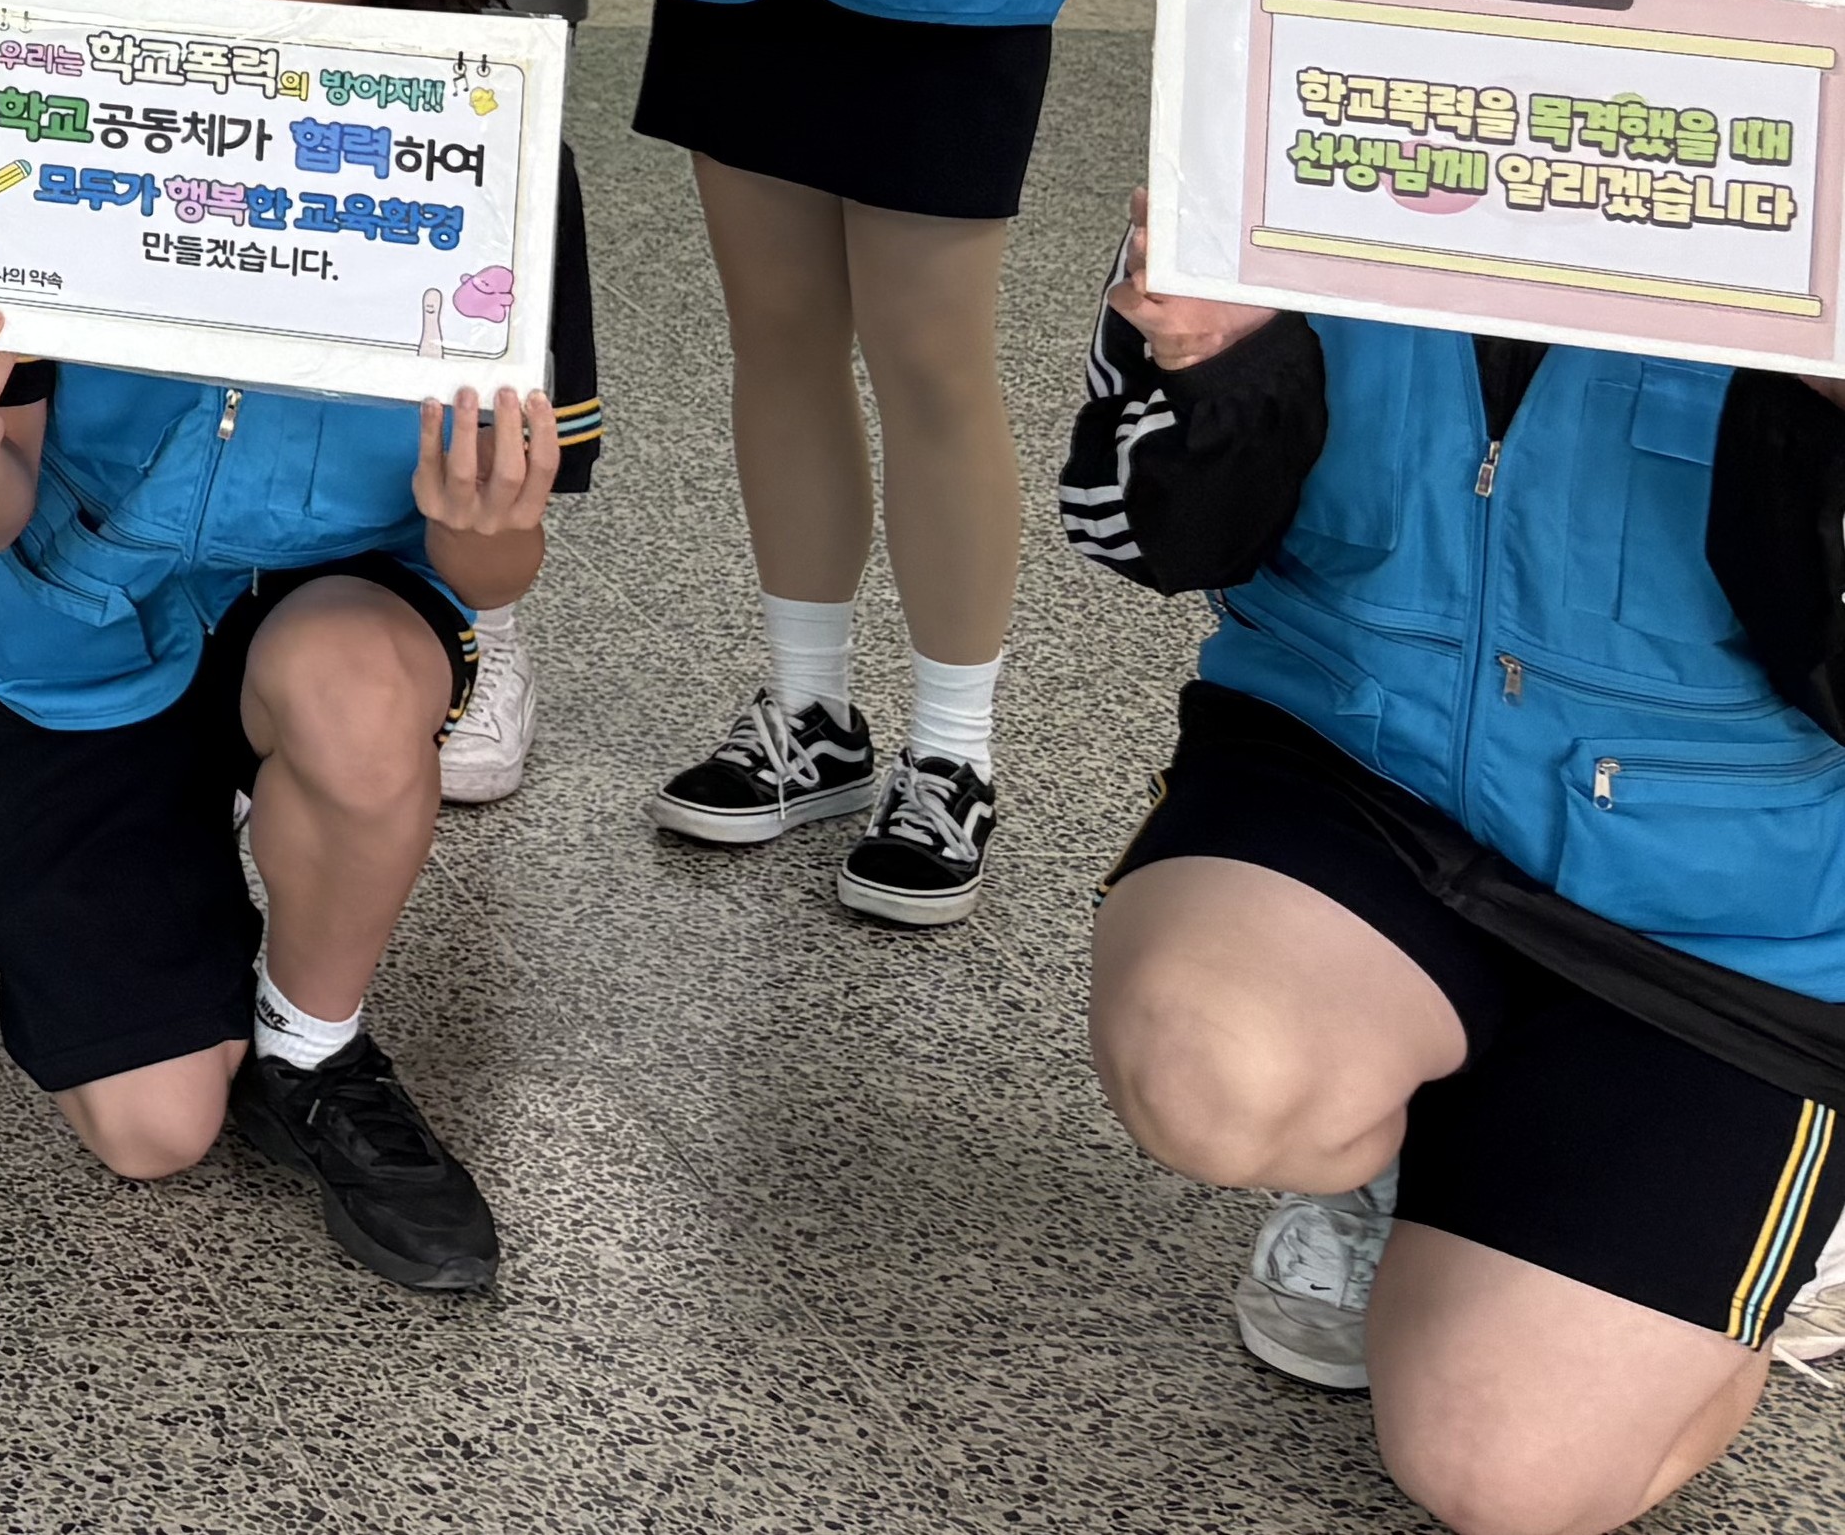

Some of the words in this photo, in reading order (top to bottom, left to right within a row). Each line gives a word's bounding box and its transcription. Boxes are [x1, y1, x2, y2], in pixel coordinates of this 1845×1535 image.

[86, 31, 310, 102] 학교폭력의
[319, 68, 446, 113] 방어자!!
[289, 116, 486, 187] 협력하여
[1296, 66, 1520, 144] 학교폭력을
[1527, 92, 1721, 165] 목격했을
[1730, 116, 1794, 167] 때
[33, 162, 161, 216] 모두가
[165, 174, 294, 230] 행복한
[293, 190, 465, 251] 교육환경
[1286, 130, 1490, 195] 선생님께
[1495, 155, 1799, 230] 알리겠습니다
[29, 269, 64, 291] 약속
[142, 231, 340, 282] 만들겠습니다.
